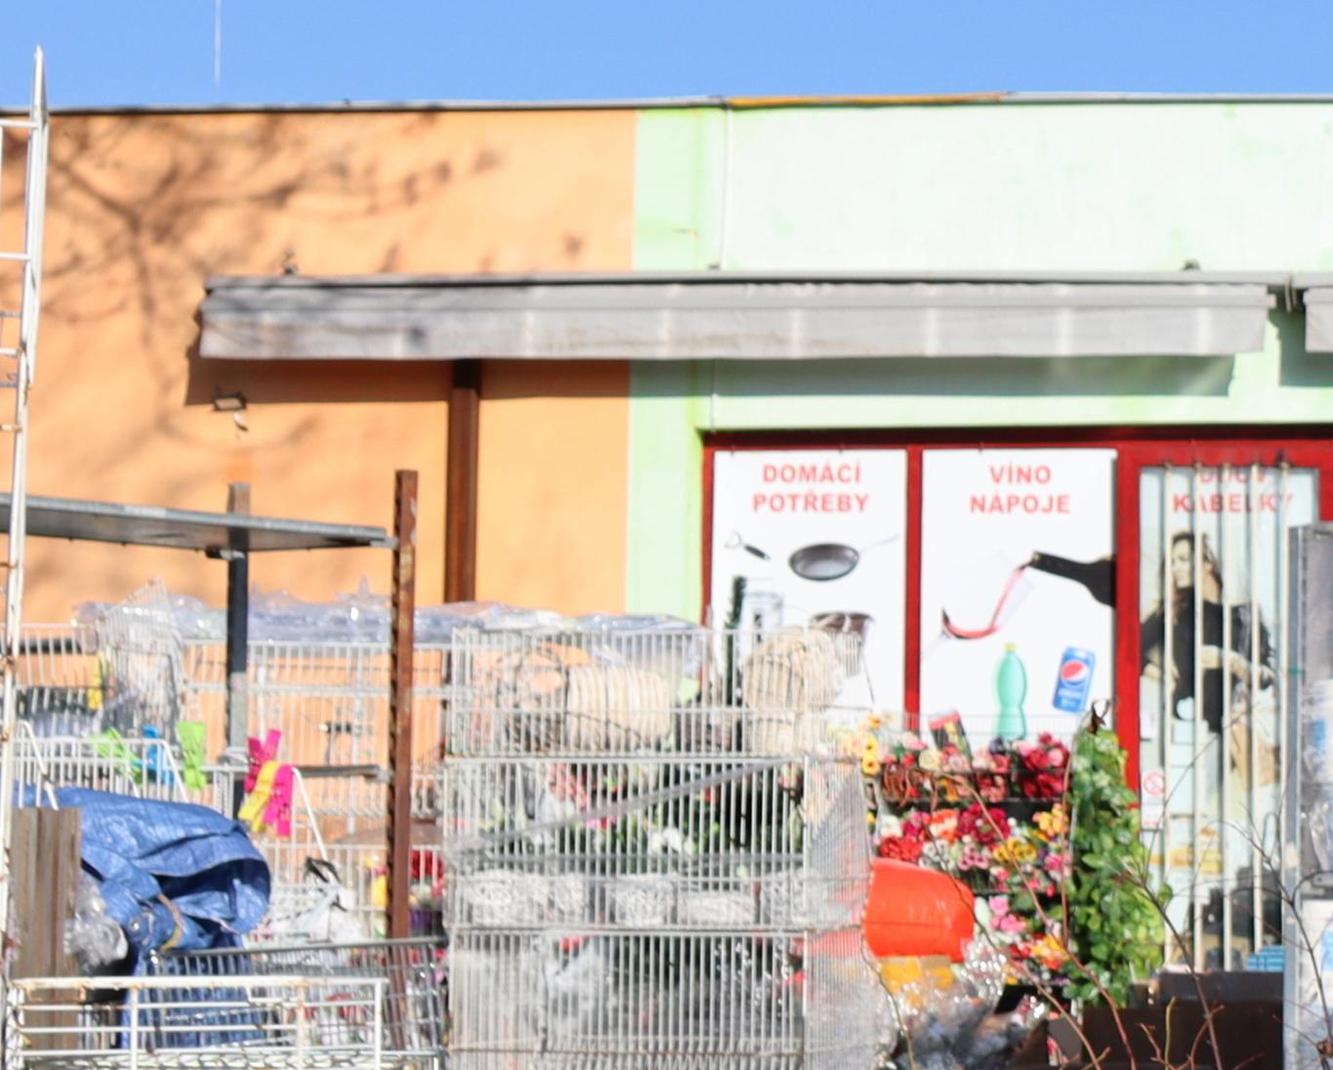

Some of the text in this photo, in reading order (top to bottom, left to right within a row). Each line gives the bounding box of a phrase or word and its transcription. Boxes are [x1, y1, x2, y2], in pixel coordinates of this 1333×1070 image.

[762, 463, 862, 483] DOMÁCÍ
[989, 462, 1052, 485] VÍNO
[752, 490, 869, 513] POTŘEBY
[969, 491, 1071, 514] NÁPOJE
